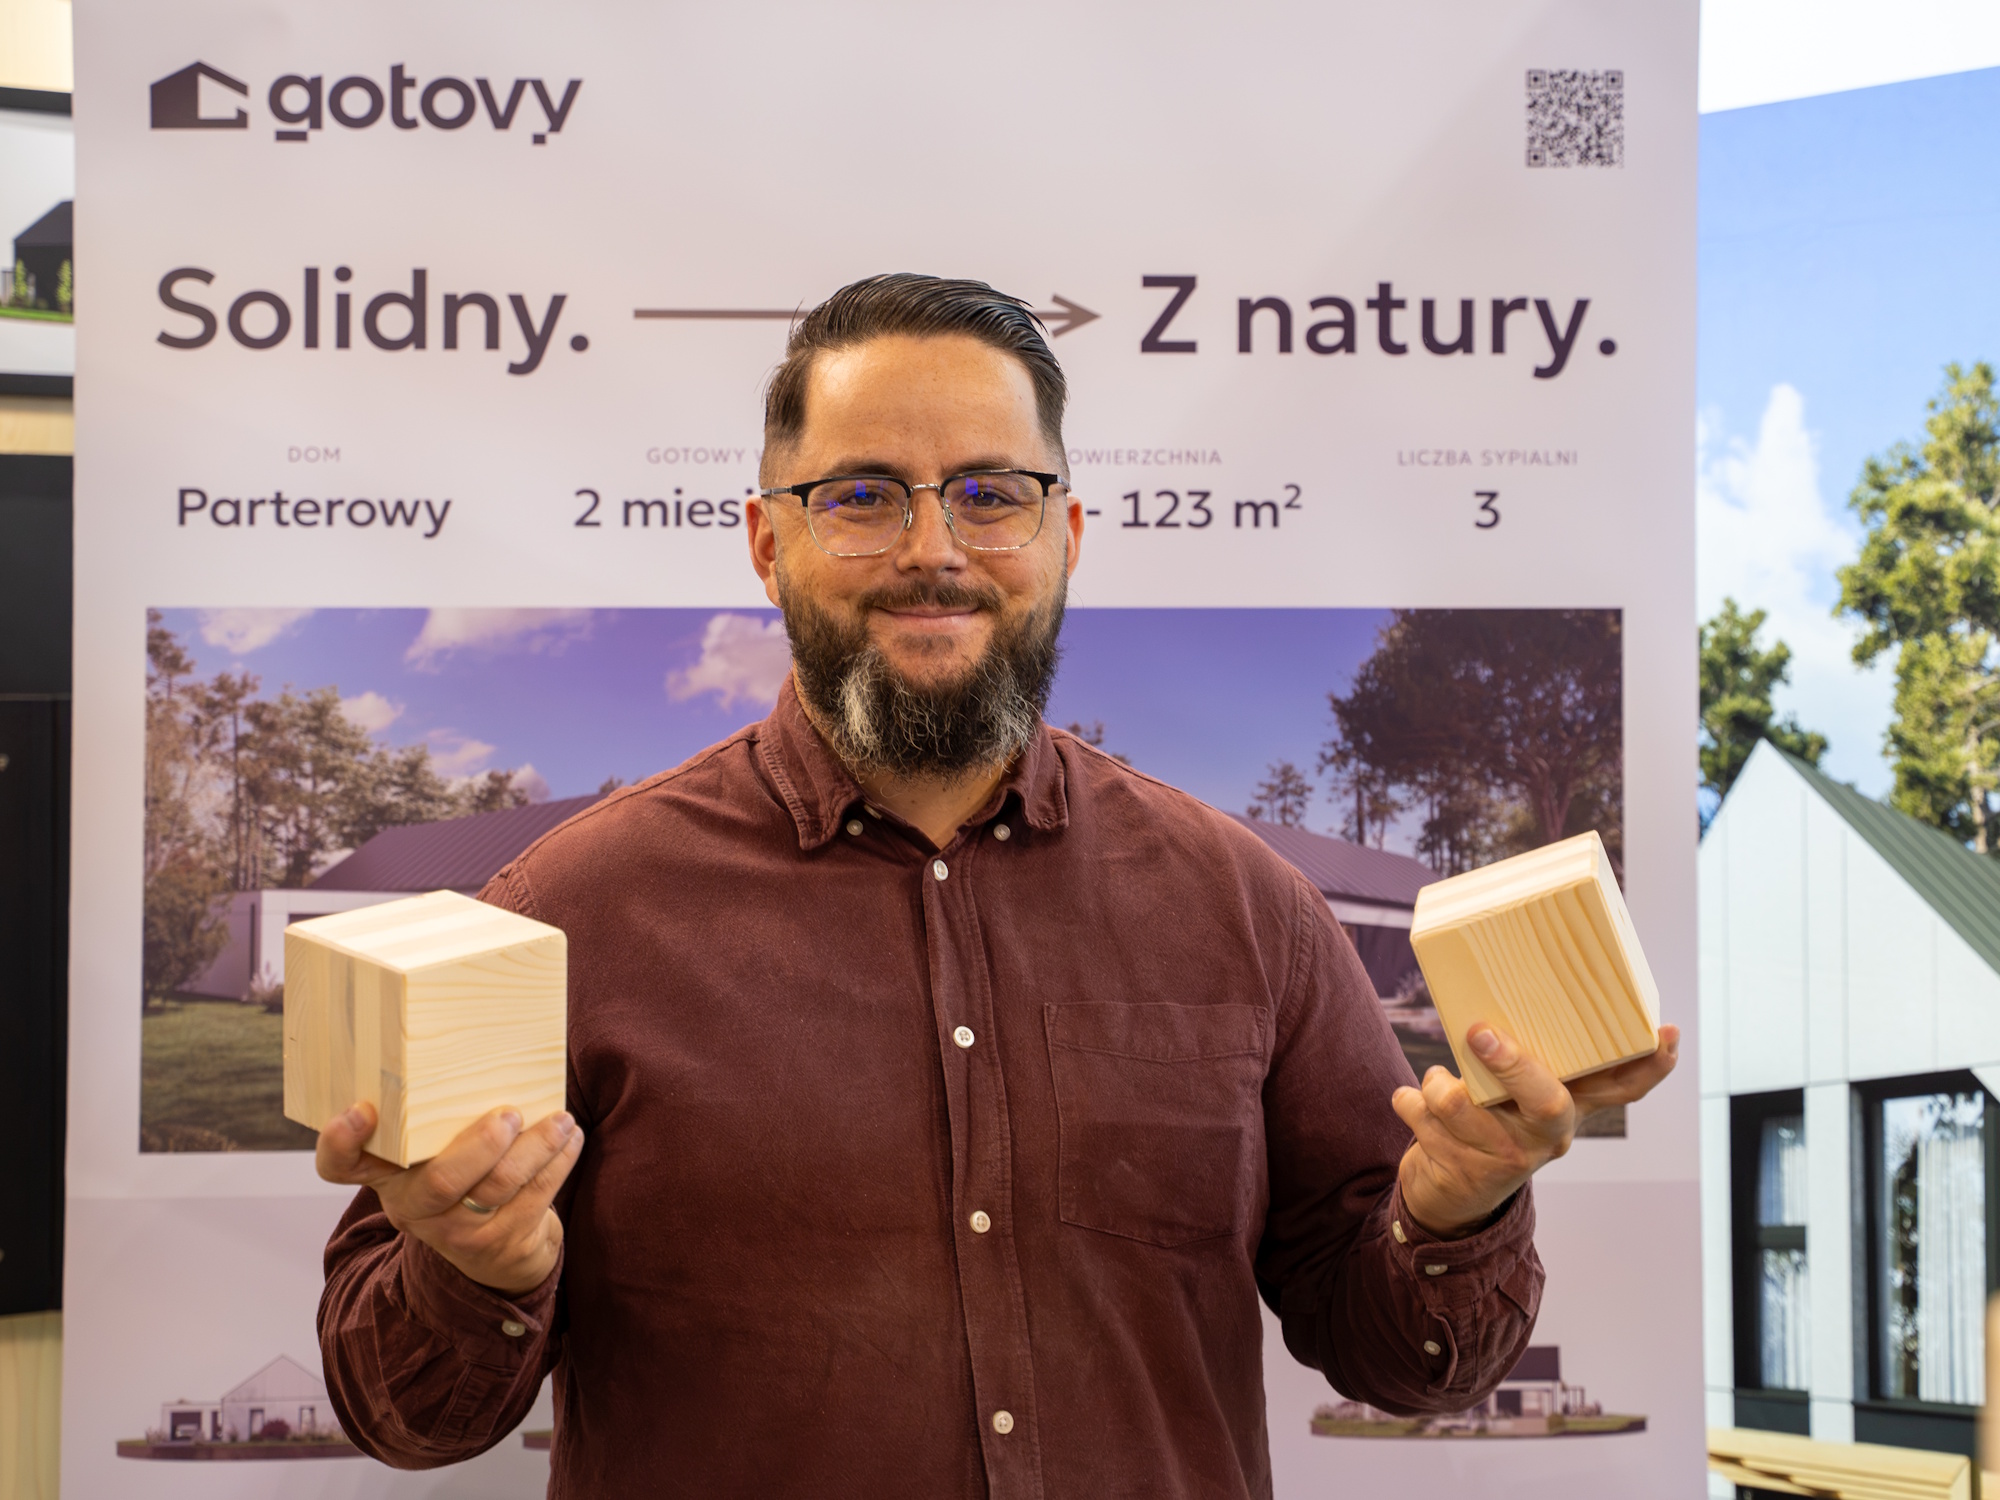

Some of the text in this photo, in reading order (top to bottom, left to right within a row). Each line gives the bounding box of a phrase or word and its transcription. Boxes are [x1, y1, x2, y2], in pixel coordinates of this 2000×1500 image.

[266, 63, 584, 146] gotovy
[155, 265, 591, 377] Solidny.
[1139, 274, 1619, 380] Z natury.
[287, 445, 342, 464] DOM
[645, 446, 746, 466] GOTOWY
[1066, 448, 1224, 467] OWIERZCHNIA
[1396, 448, 1579, 467] LICZBA SYPIALNI
[177, 487, 453, 540] Parterowy
[573, 487, 754, 529] 2 mies
[1120, 489, 1215, 530] 123
[1473, 490, 1502, 530] 3
